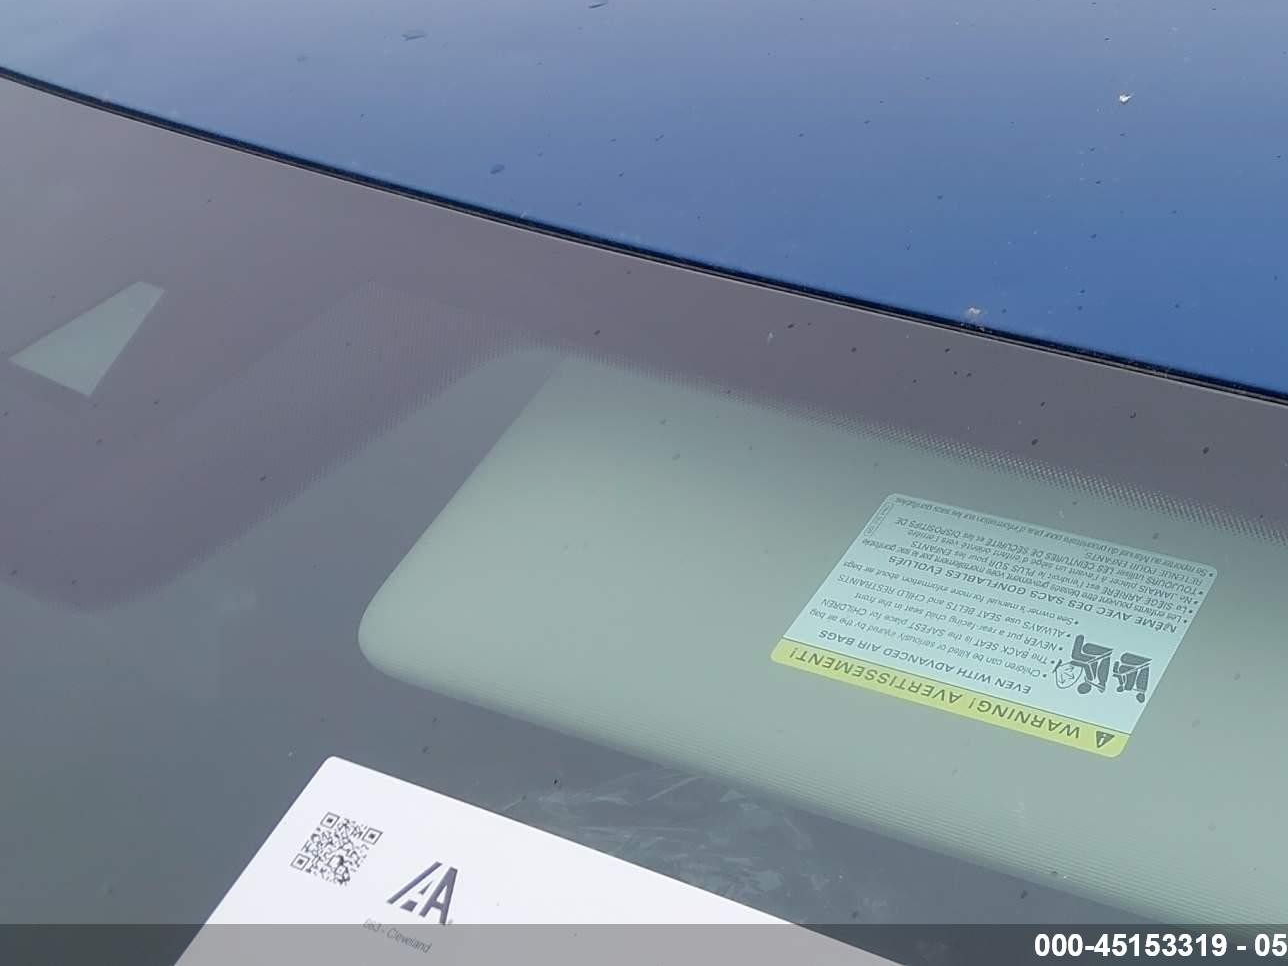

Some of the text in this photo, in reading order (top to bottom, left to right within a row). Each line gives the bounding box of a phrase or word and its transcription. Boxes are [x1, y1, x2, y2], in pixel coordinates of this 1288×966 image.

[873, 569, 900, 581] about
[1009, 564, 1036, 575] PLUS
[899, 575, 949, 593] information
[852, 592, 876, 604] front
[886, 555, 1178, 634] MÊME AVEC DES SACS GONFLABLES ÉVOLUÉS
[835, 573, 1065, 638] ALWAYS use SEAT BELTS and CHILD RESTRAINTS
[875, 598, 893, 608] the
[891, 602, 903, 611] in
[806, 608, 827, 620] bag
[902, 605, 924, 616] seat
[923, 610, 947, 622] child
[824, 614, 838, 623] air
[836, 617, 854, 627] the
[1054, 614, 1074, 625] See
[819, 598, 1050, 664] The BACK SEAT is the SAFEST place for CHILDREN
[1004, 630, 1024, 642] put
[896, 631, 936, 649] seriously
[1022, 636, 1058, 651] NEVER
[935, 643, 947, 651] or
[945, 646, 971, 658] killed
[817, 629, 1032, 694] EVEN WITH ADVANCED AIR BAGS
[970, 652, 984, 662] be
[984, 656, 1003, 665] can
[1001, 660, 1042, 678] Children
[787, 647, 1084, 738] WARNING! AVERTISSEMENT!
[386, 927, 432, 954] Cleveland
